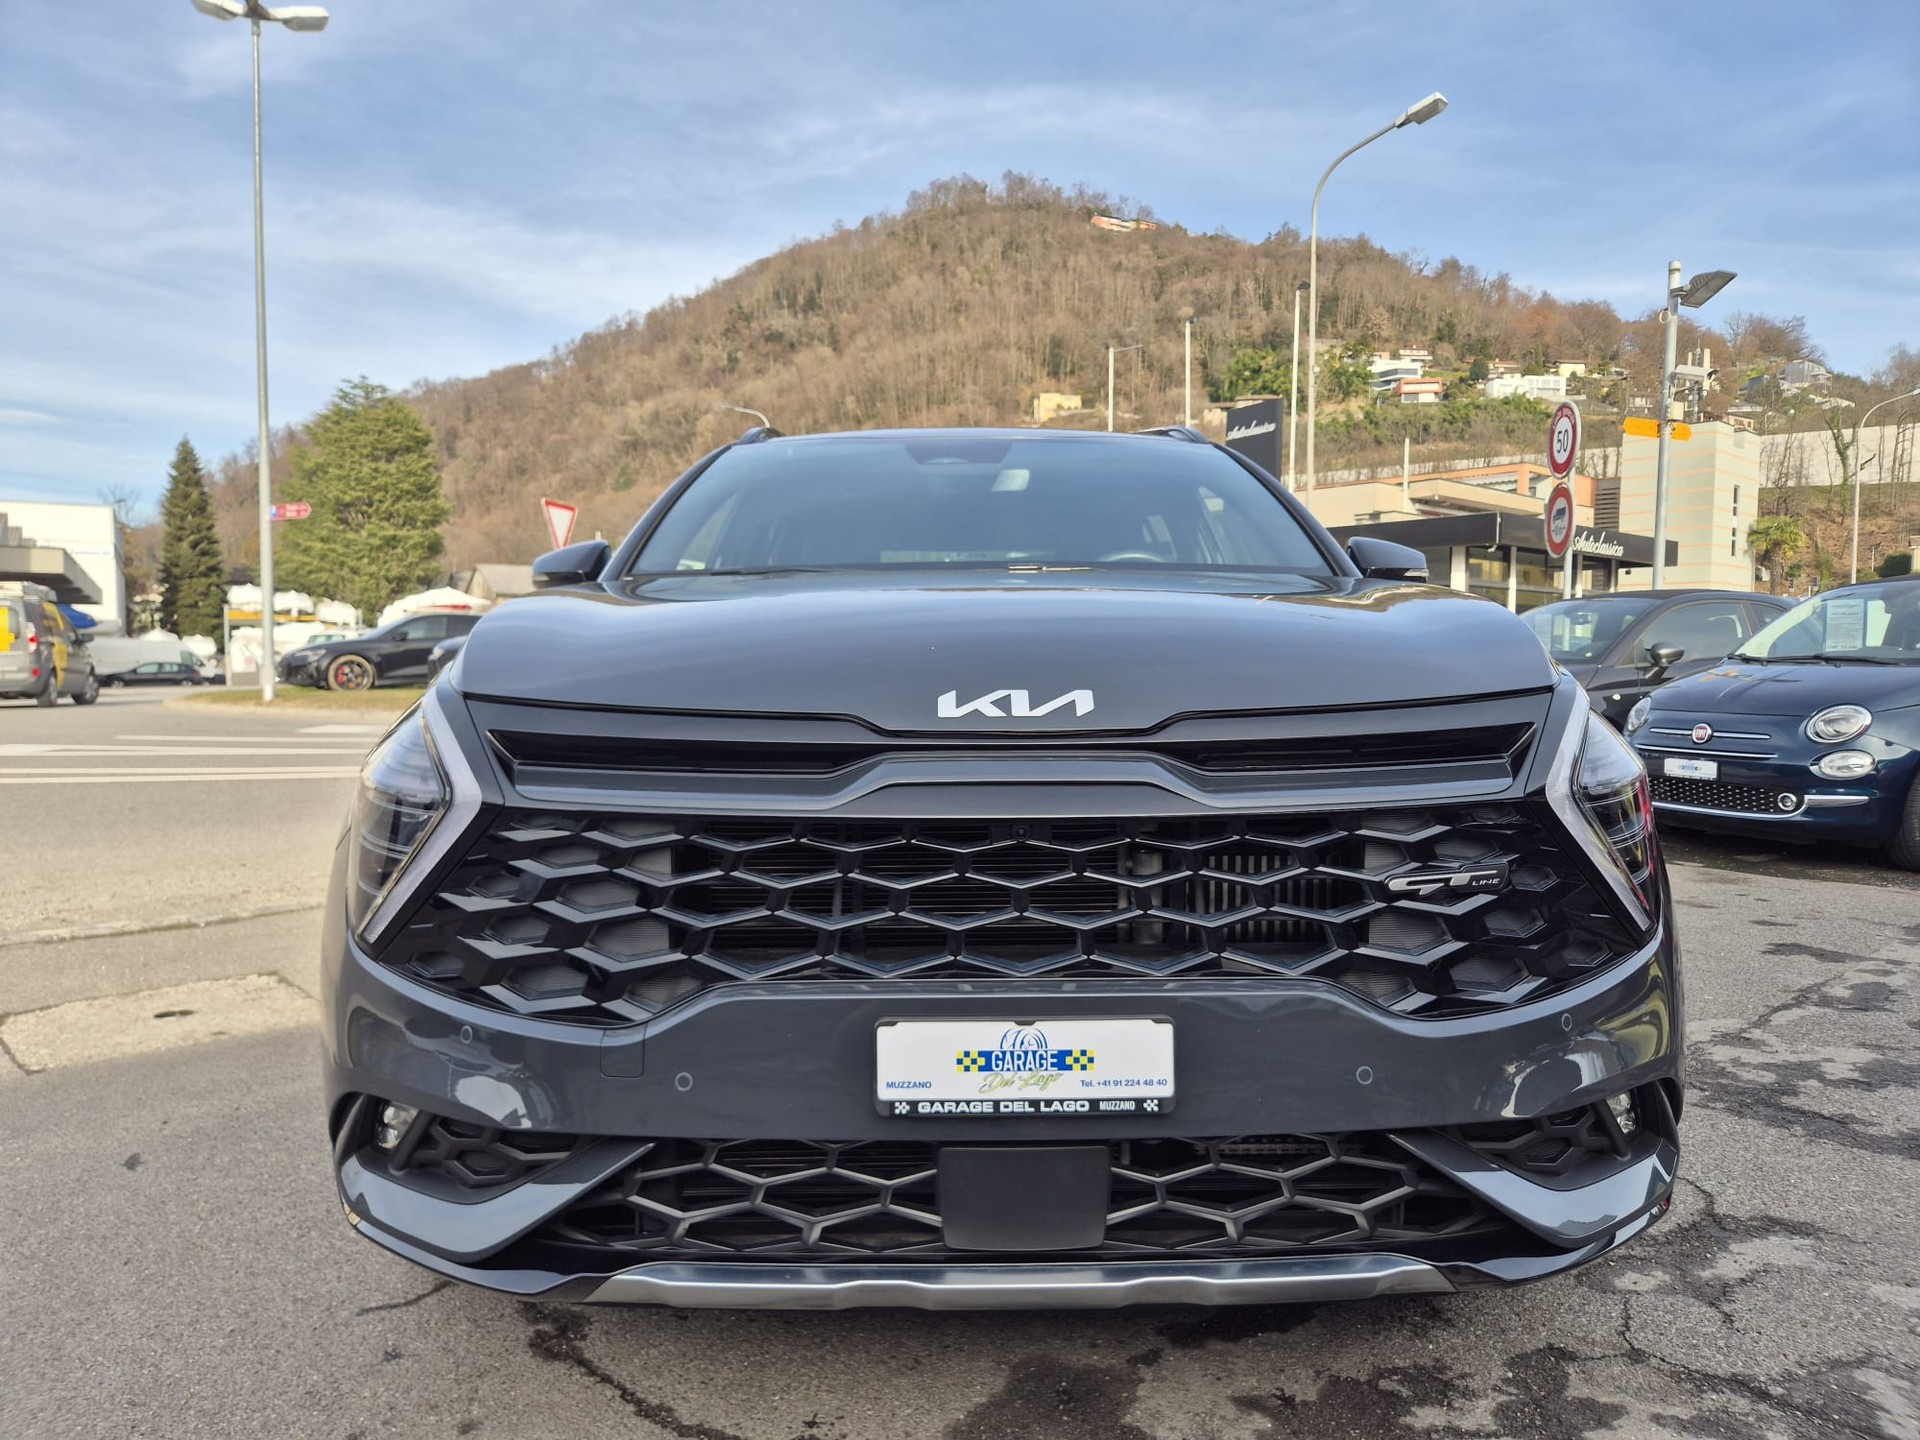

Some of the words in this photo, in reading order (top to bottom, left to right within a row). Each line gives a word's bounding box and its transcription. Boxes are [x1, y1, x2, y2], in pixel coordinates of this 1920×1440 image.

[1557, 429, 1569, 454] 50
[1572, 530, 1624, 557] Autoclassica
[1472, 878, 1501, 887] LINE
[991, 1050, 1059, 1072] GARAGE
[886, 1081, 932, 1089] MUZZANO
[1080, 1079, 1095, 1088] Tel.
[1124, 1079, 1140, 1087] 224
[1143, 1078, 1154, 1087] 48
[1156, 1078, 1168, 1087] 40
[917, 1101, 995, 1114] GARAGE
[999, 1101, 1035, 1113] DEL
[1040, 1100, 1090, 1112] LAGO
[1099, 1100, 1136, 1111] MUZZANO
